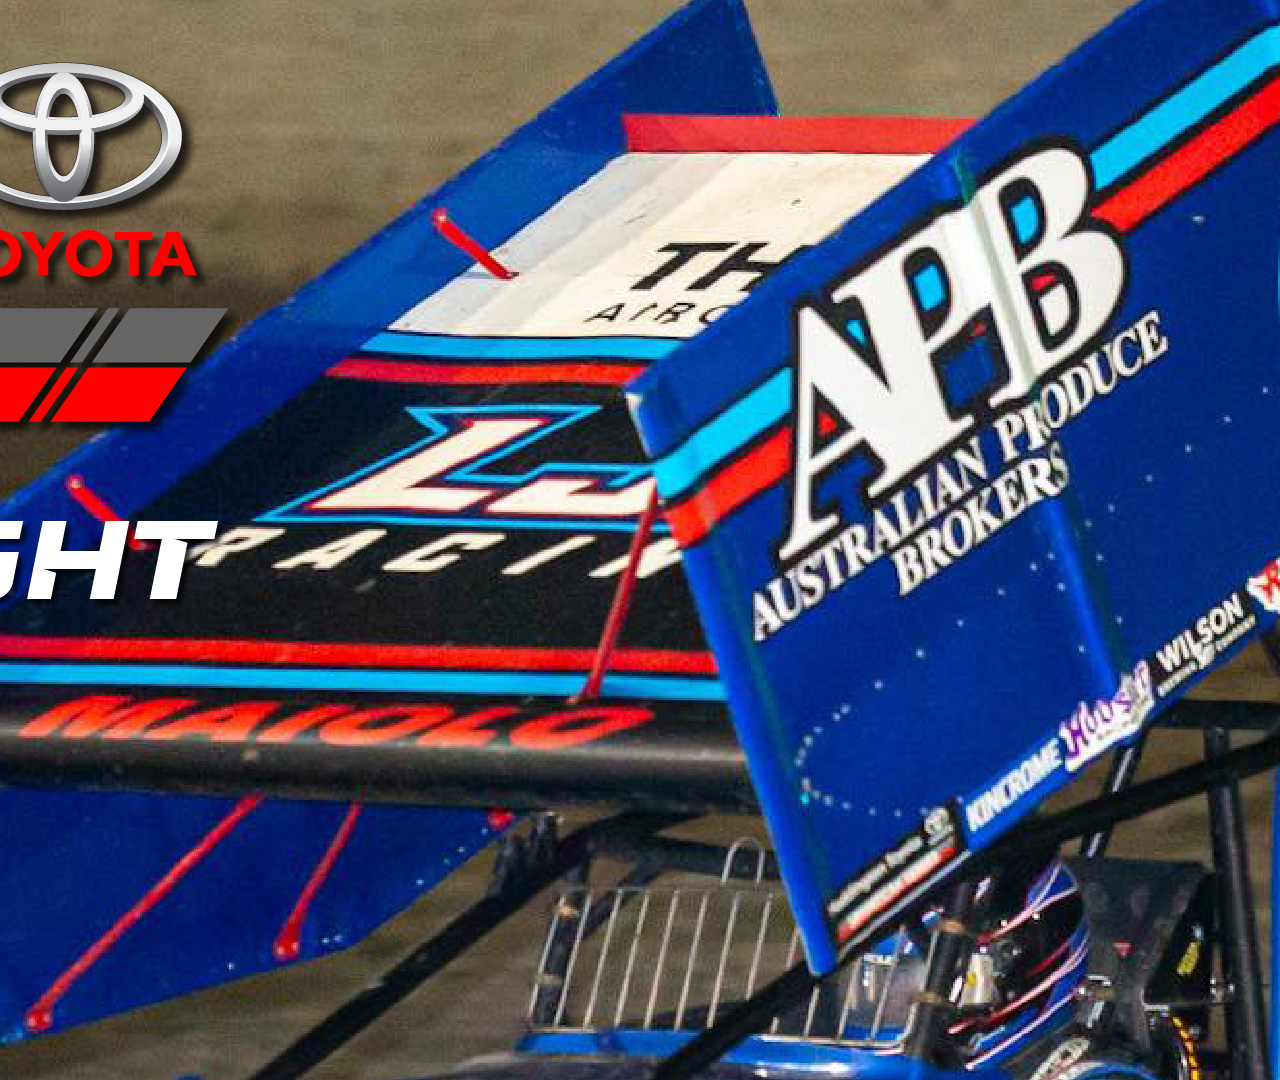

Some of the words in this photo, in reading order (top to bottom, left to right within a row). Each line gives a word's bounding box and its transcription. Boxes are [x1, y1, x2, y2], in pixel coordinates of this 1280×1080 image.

[778, 147, 1124, 562] APB
[752, 440, 987, 642] AUSTRALIAN
[995, 311, 1169, 461] PRODUCE
[893, 441, 1070, 595] BROKERS
[1156, 593, 1244, 672] WILSON
[19, 695, 654, 749] MAIOLO
